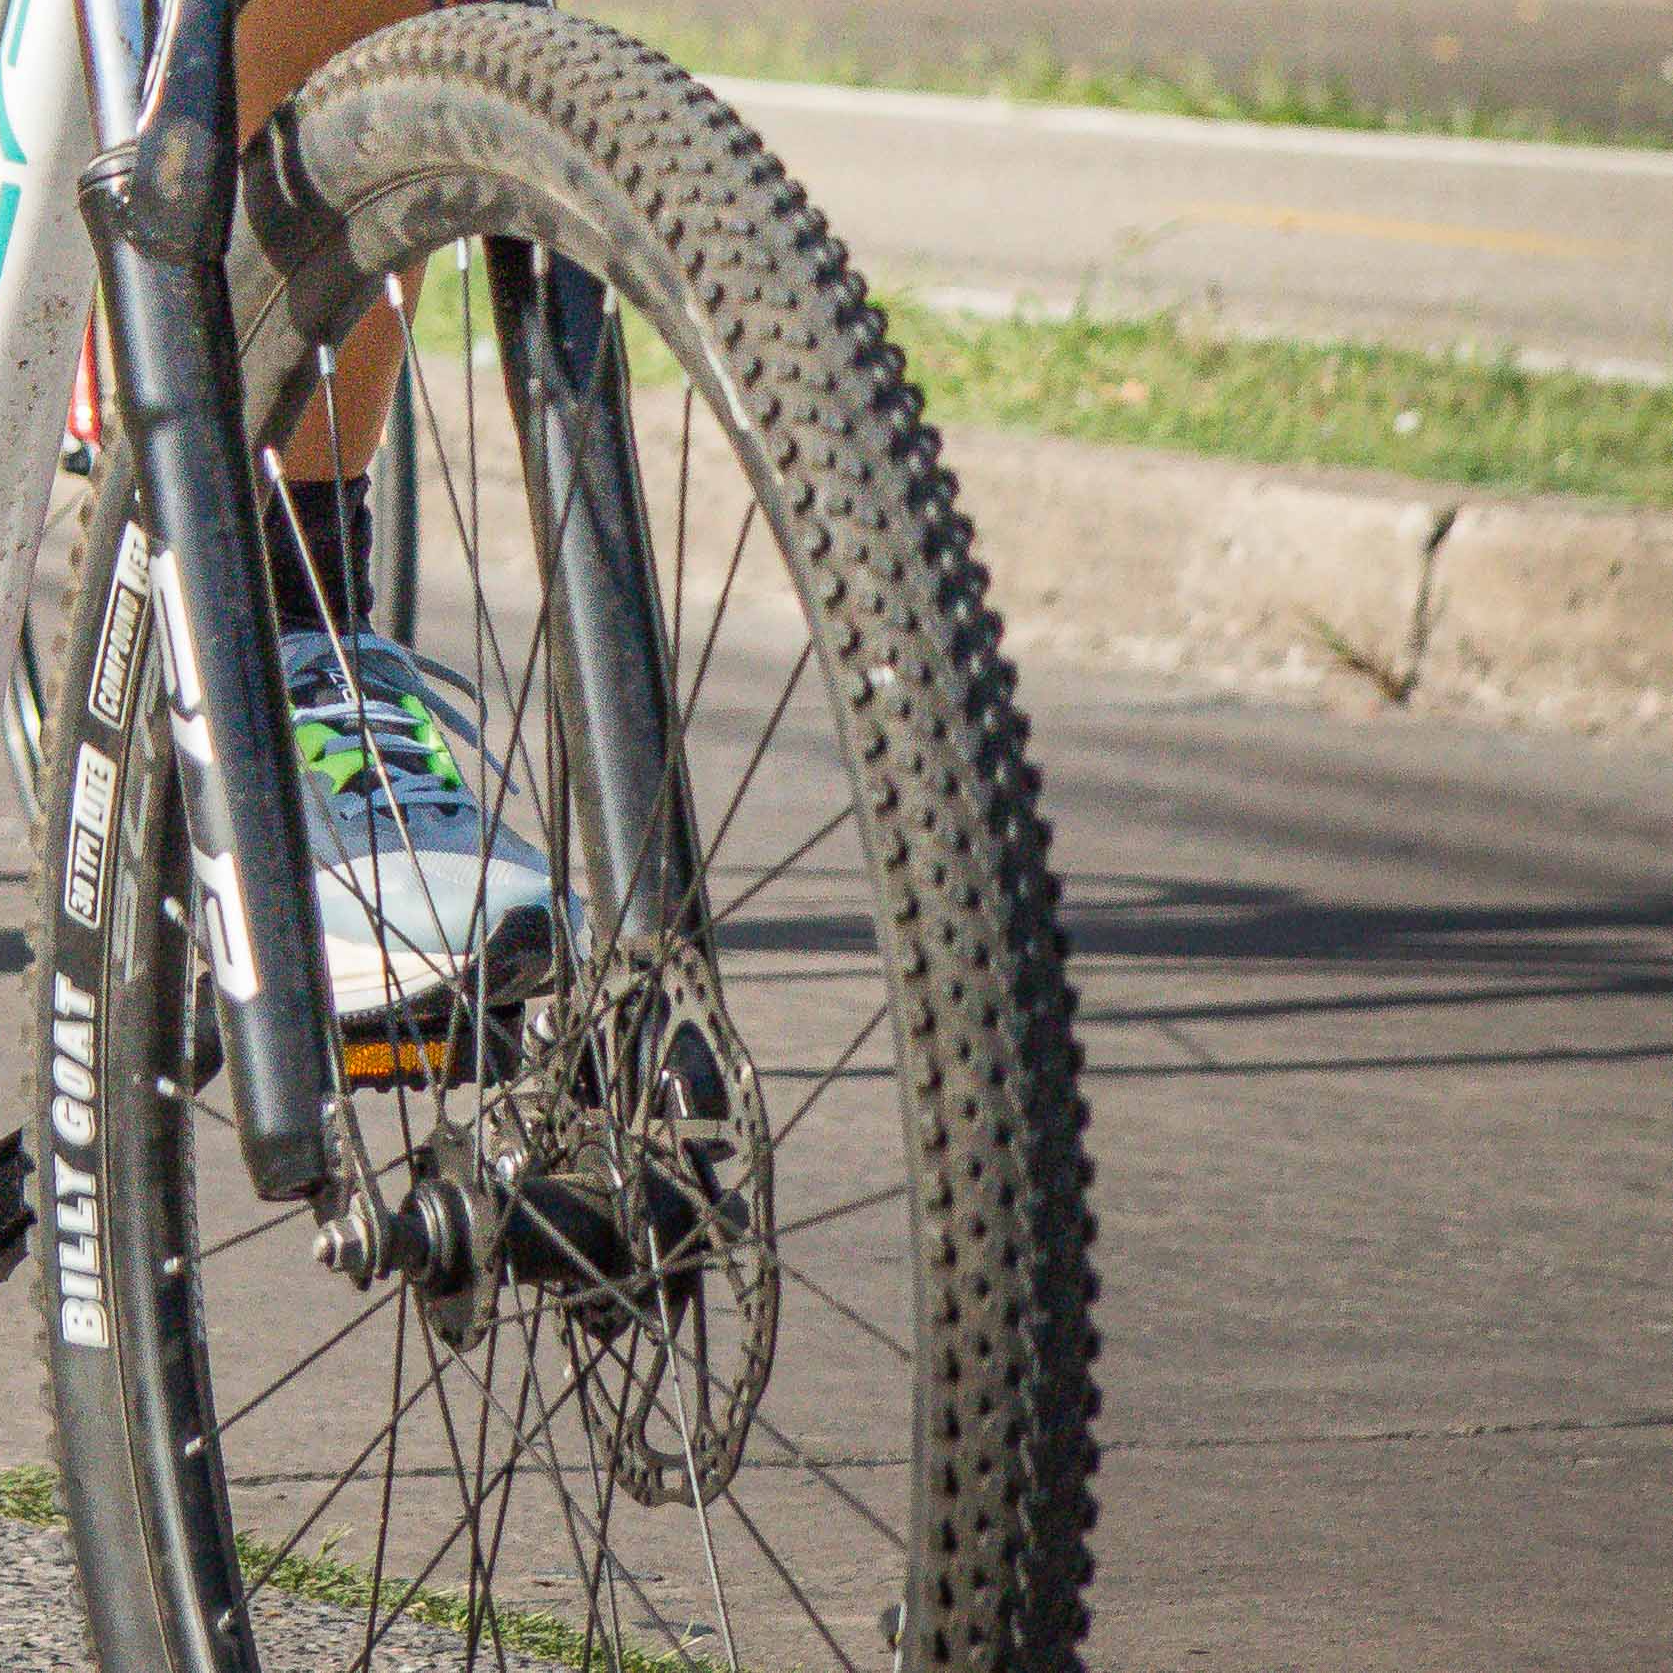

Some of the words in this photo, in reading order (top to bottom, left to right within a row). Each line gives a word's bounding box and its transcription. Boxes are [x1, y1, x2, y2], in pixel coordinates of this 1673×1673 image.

[86, 759, 112, 824] LITE
[52, 969, 97, 1147] GOAT
[54, 1151, 110, 1349] BILLY
